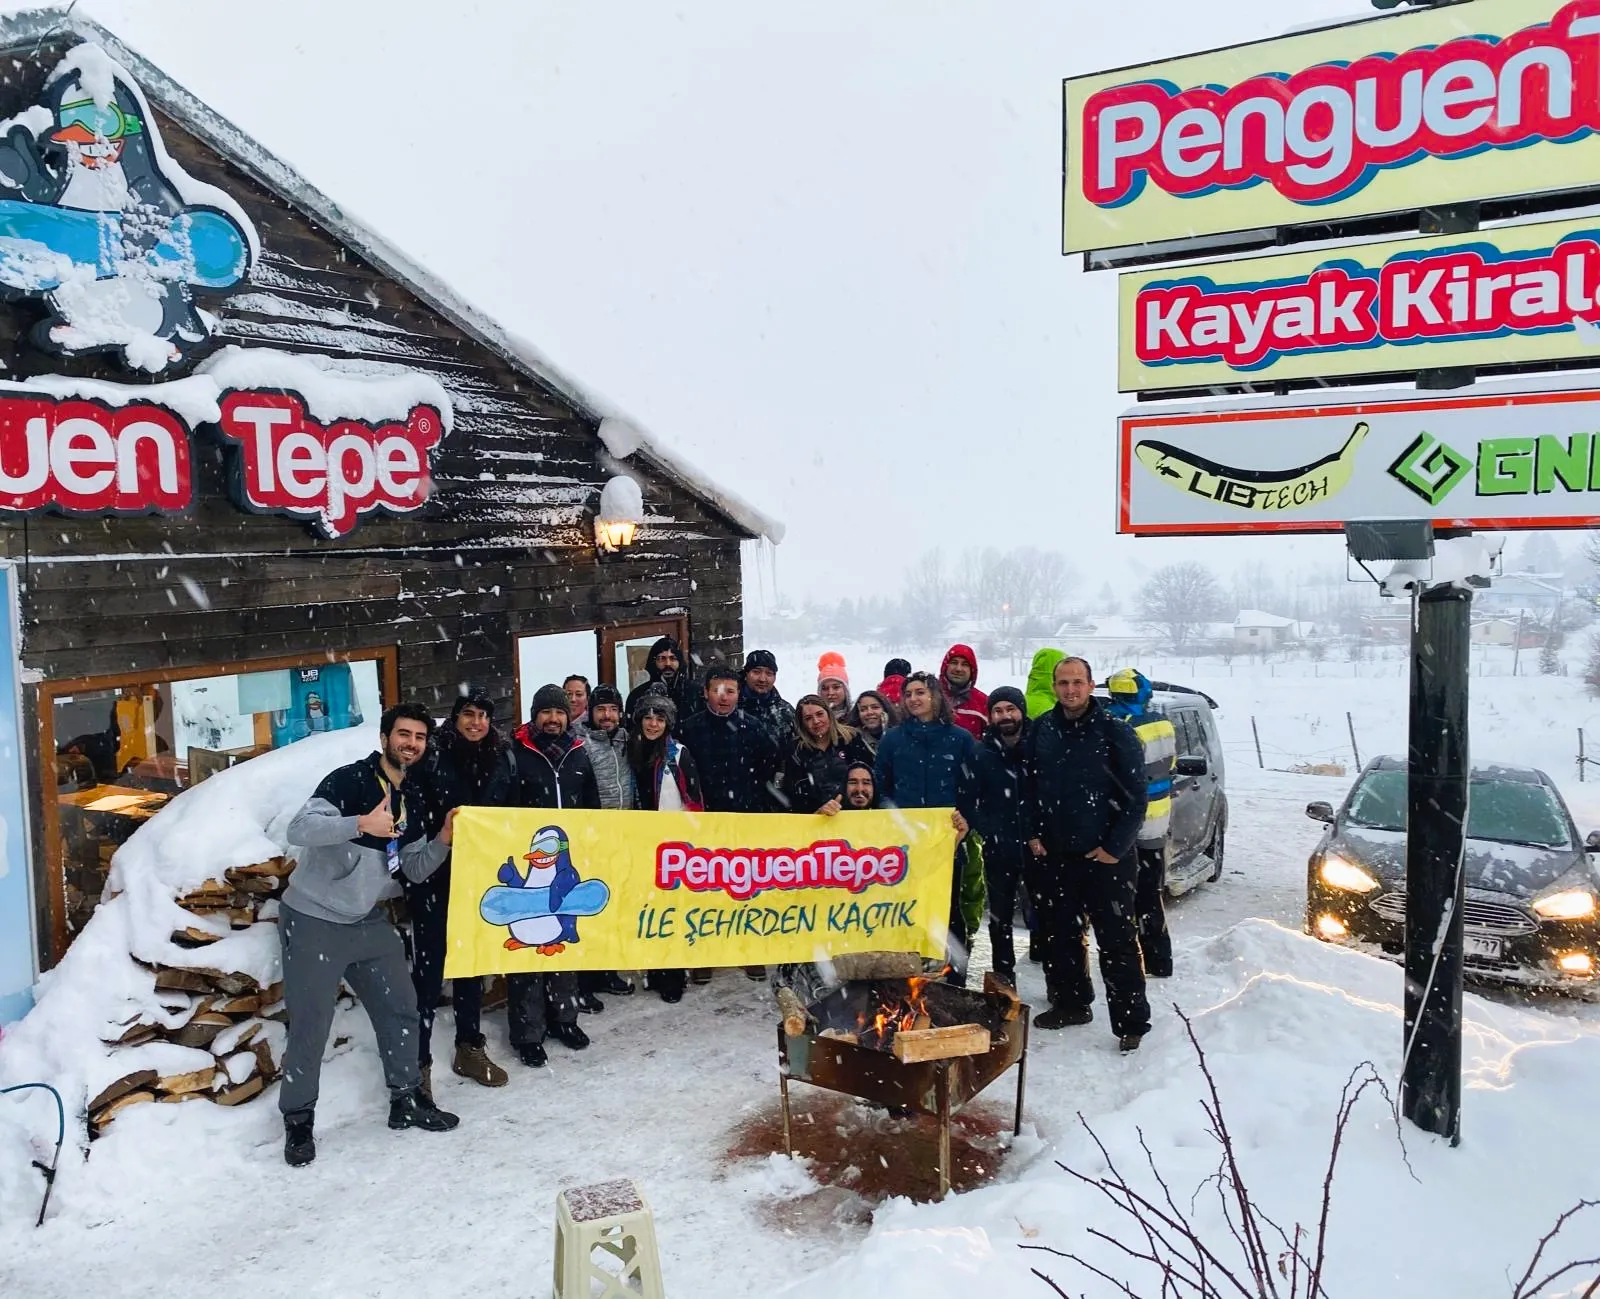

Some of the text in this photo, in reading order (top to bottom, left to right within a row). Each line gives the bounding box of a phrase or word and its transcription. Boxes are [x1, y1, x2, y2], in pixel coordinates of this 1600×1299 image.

[1145, 253, 1600, 354] Kayak Kiral
[232, 406, 421, 519] Tepe
[1475, 431, 1600, 496] GN
[637, 899, 918, 947] İLE ŞEHİRDEN KAÇTIK
